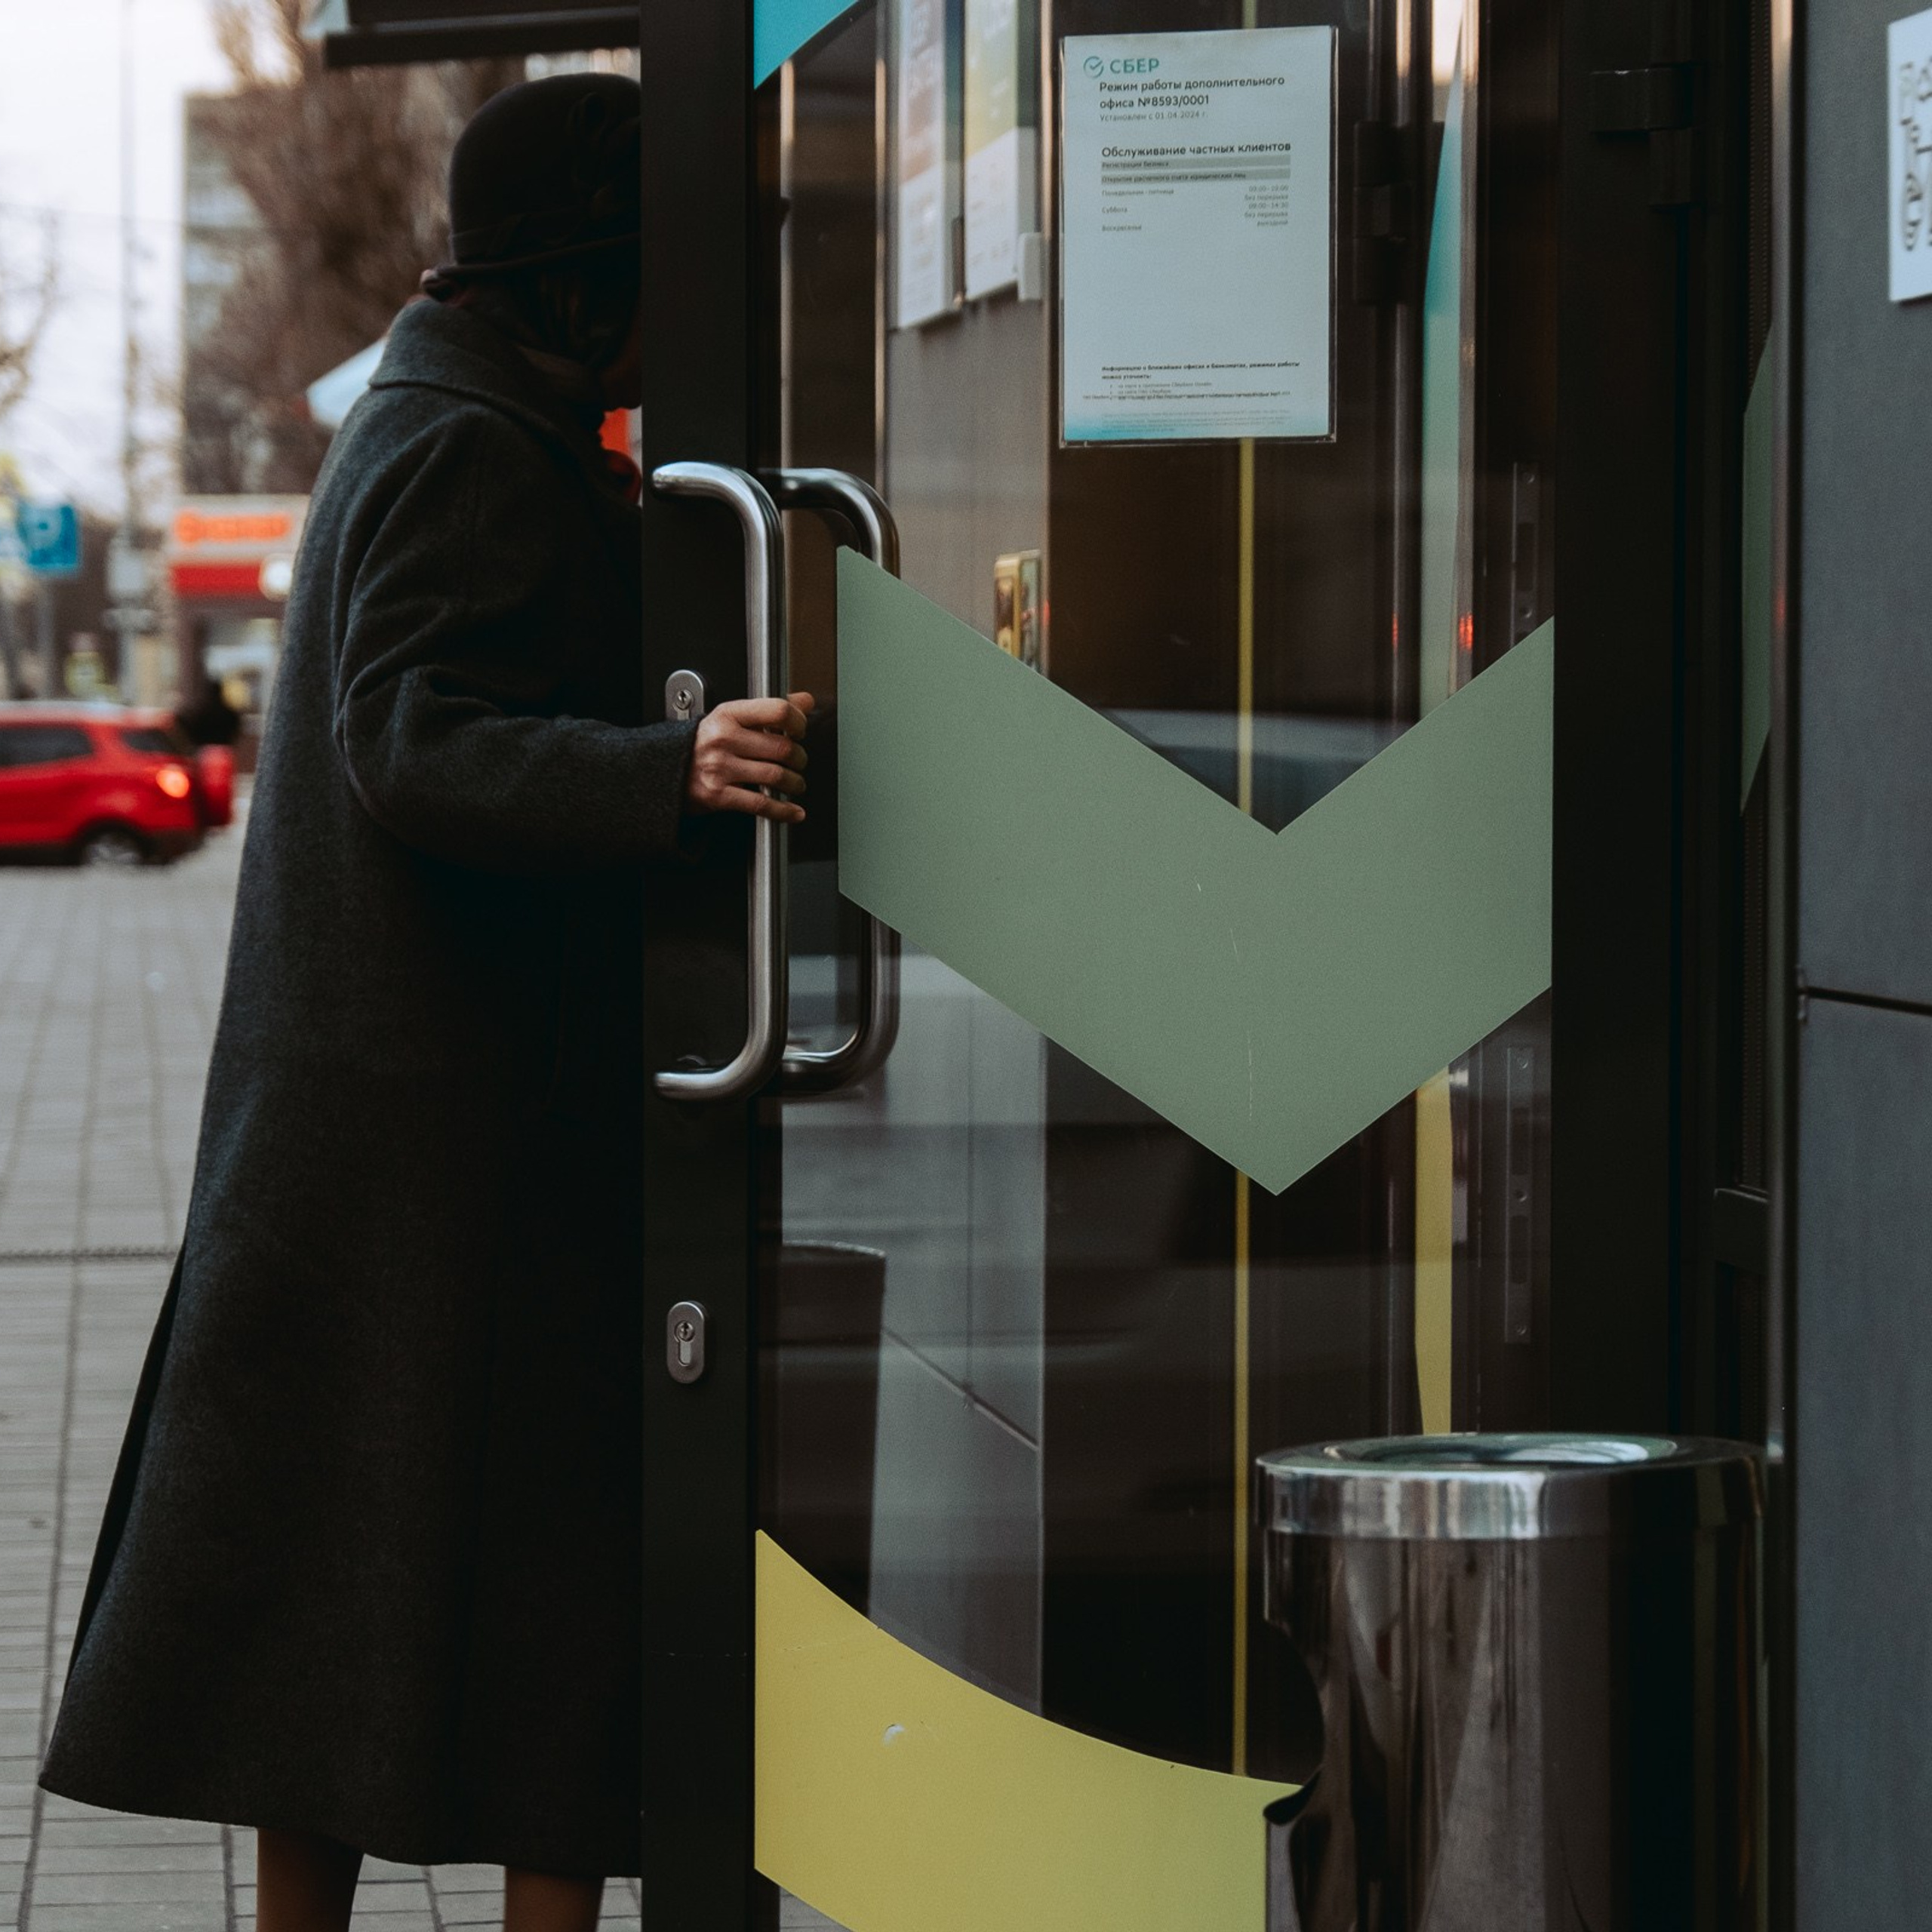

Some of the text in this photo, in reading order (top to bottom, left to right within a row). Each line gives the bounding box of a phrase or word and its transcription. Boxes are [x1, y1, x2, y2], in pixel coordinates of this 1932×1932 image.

[1109, 57, 1160, 74] СБЕР
[1099, 75, 1285, 93] Режим работы дополнительного
[1100, 94, 1210, 109] офиса №8593/0001
[1100, 112, 1146, 122] Установлен
[1101, 142, 1291, 158] Обслуживание частных клиентов
